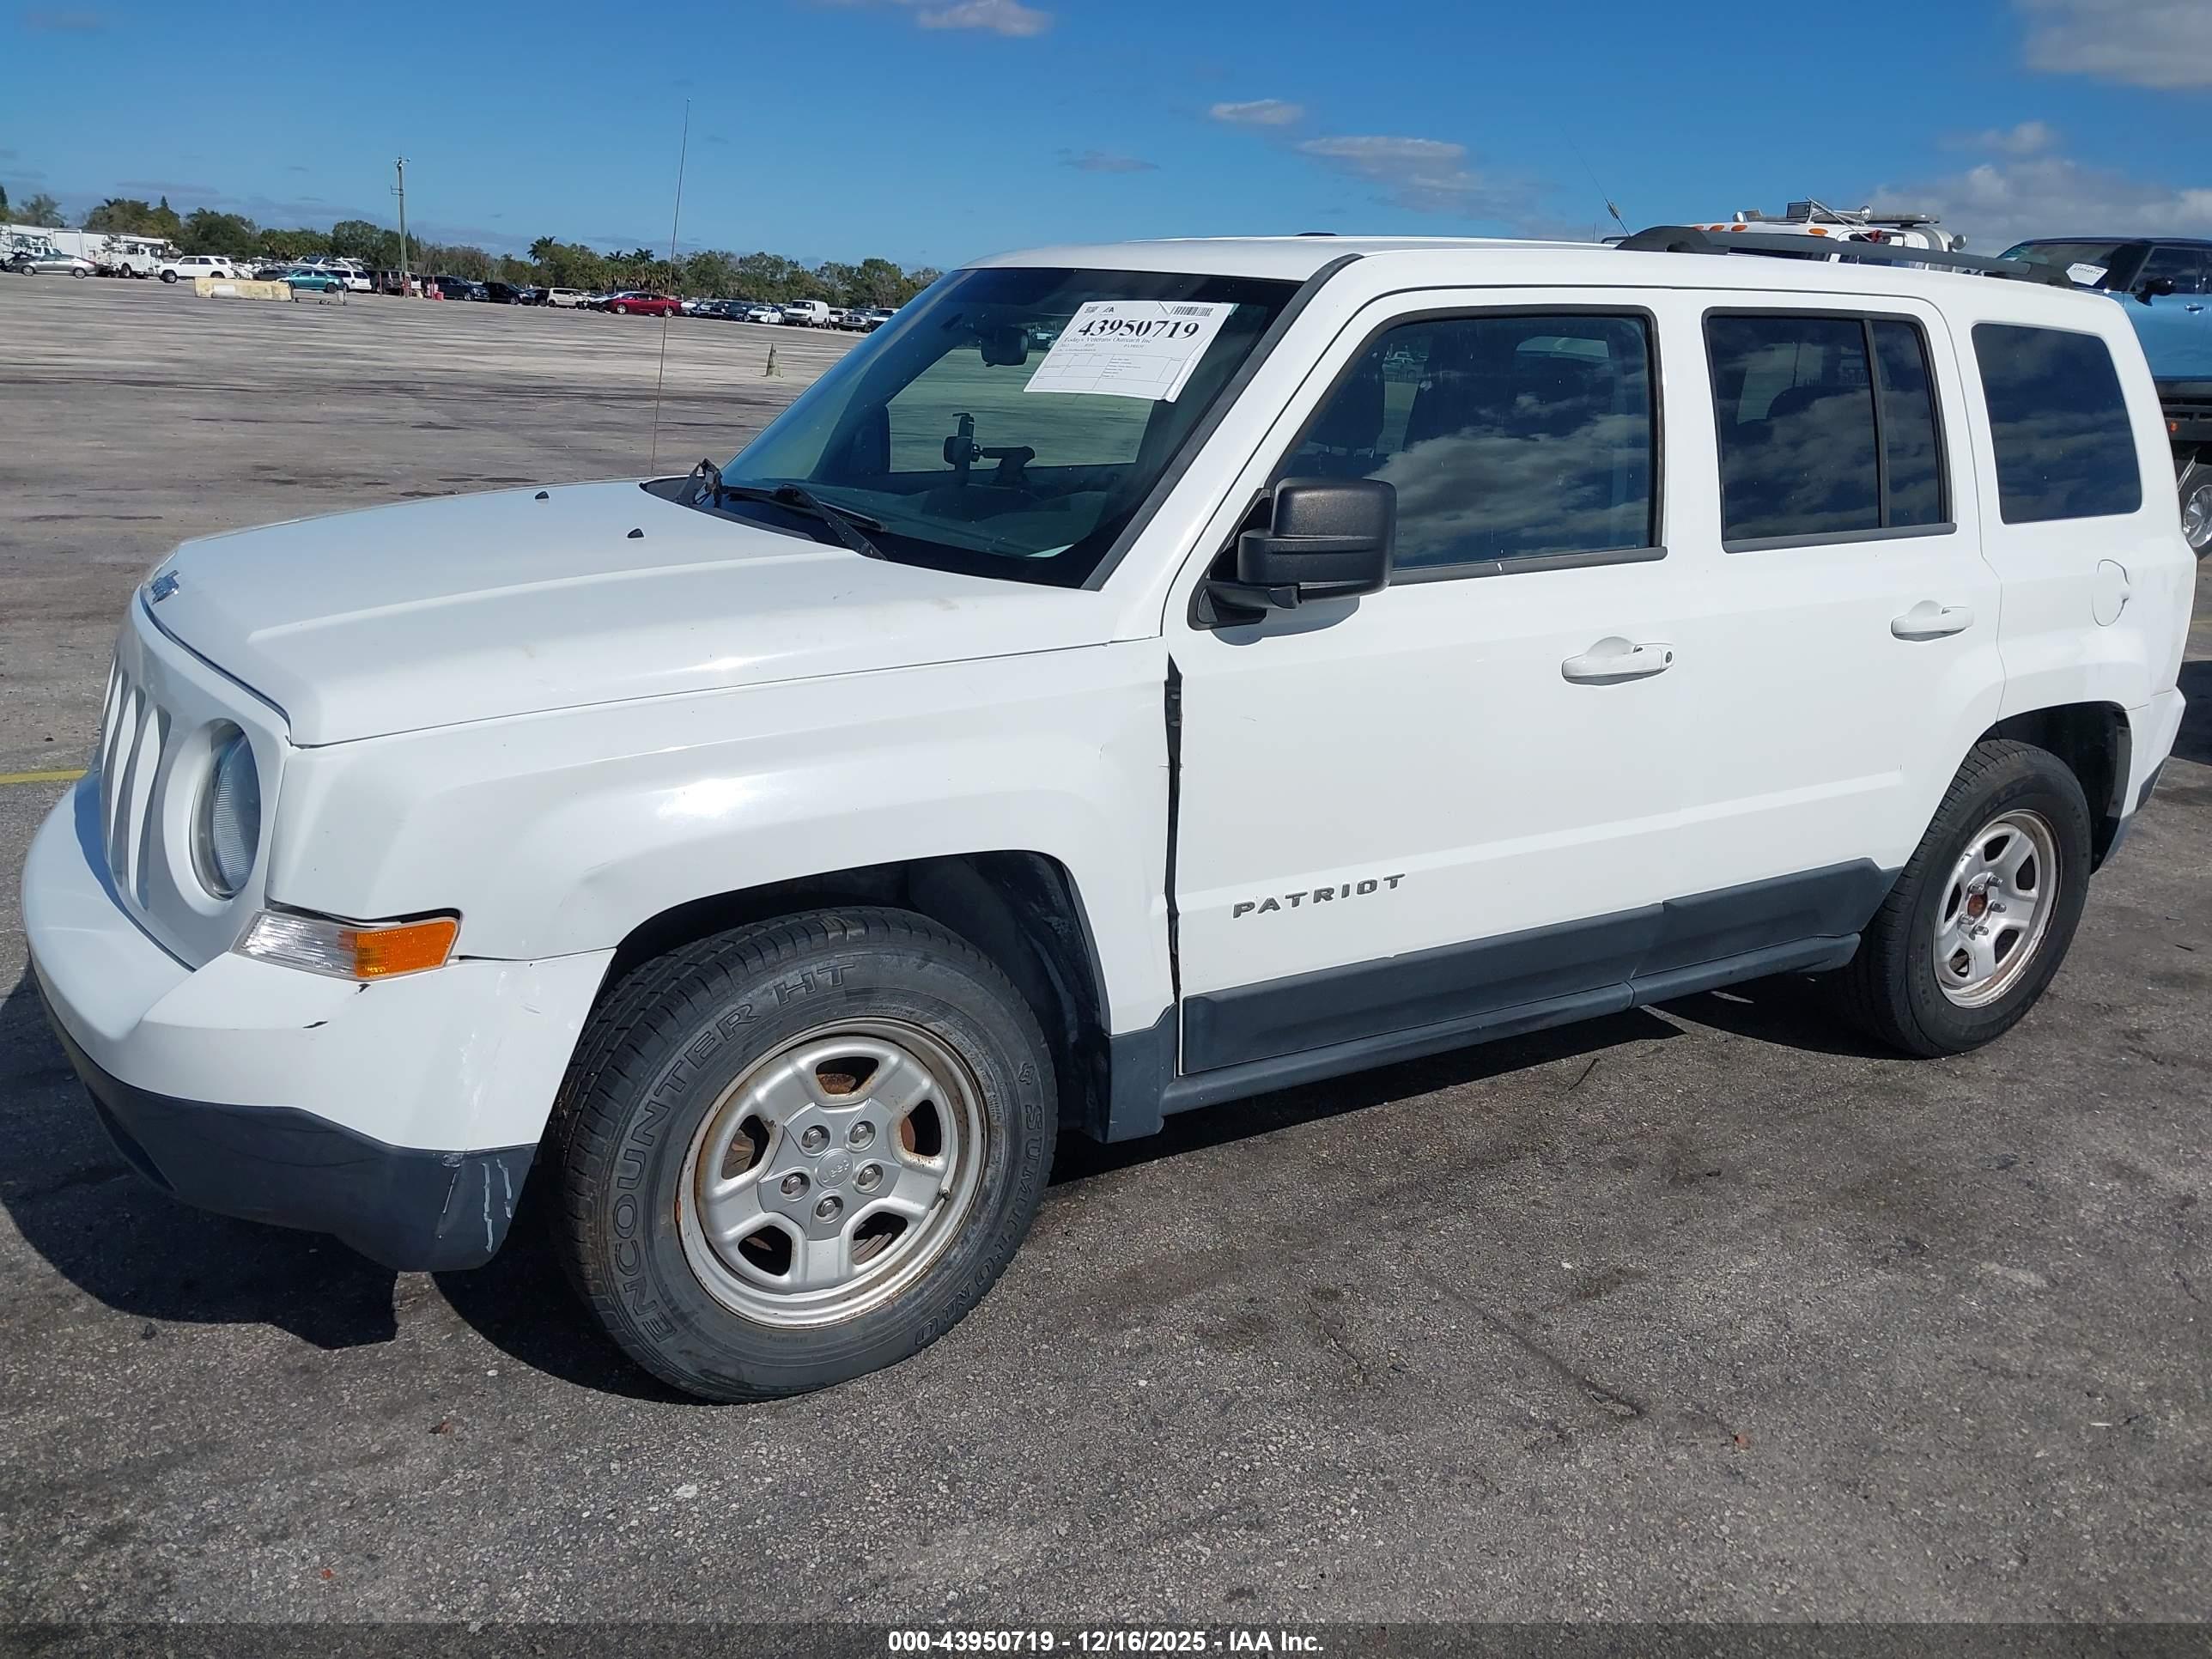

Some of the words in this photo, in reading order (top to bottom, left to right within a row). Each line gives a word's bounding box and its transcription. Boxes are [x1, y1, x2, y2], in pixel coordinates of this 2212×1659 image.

[1078, 319, 1200, 340] 43950719
[1232, 872, 1407, 919] PATRIOT
[612, 1002, 763, 1344] ENCOUNTER
[774, 959, 855, 1006] HT
